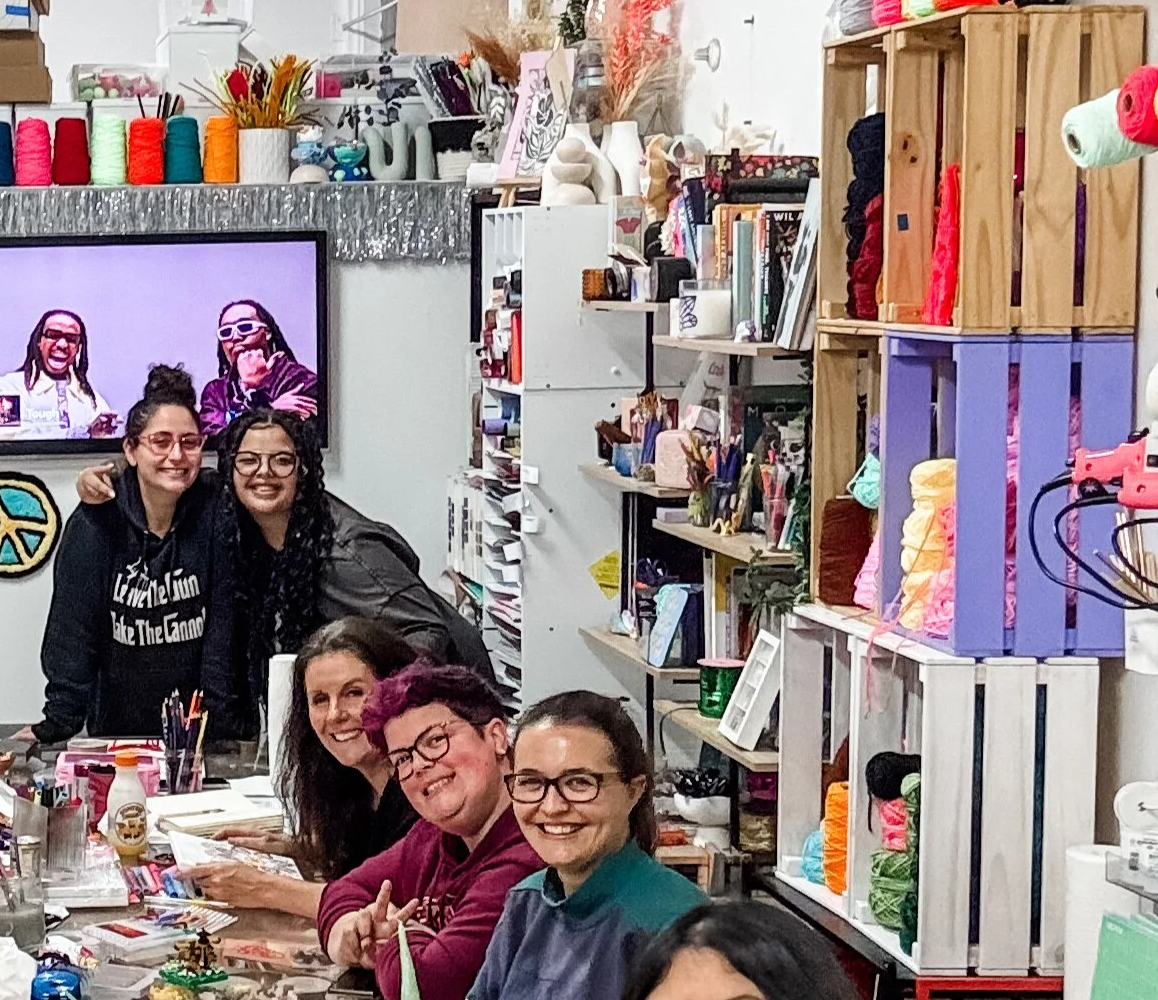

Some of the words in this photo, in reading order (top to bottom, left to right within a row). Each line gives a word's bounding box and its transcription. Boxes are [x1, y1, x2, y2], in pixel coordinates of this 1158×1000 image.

[773, 212, 795, 222] WIL
[25, 408, 60, 421] Tough
[164, 568, 200, 603] Gun
[134, 619, 164, 646] The
